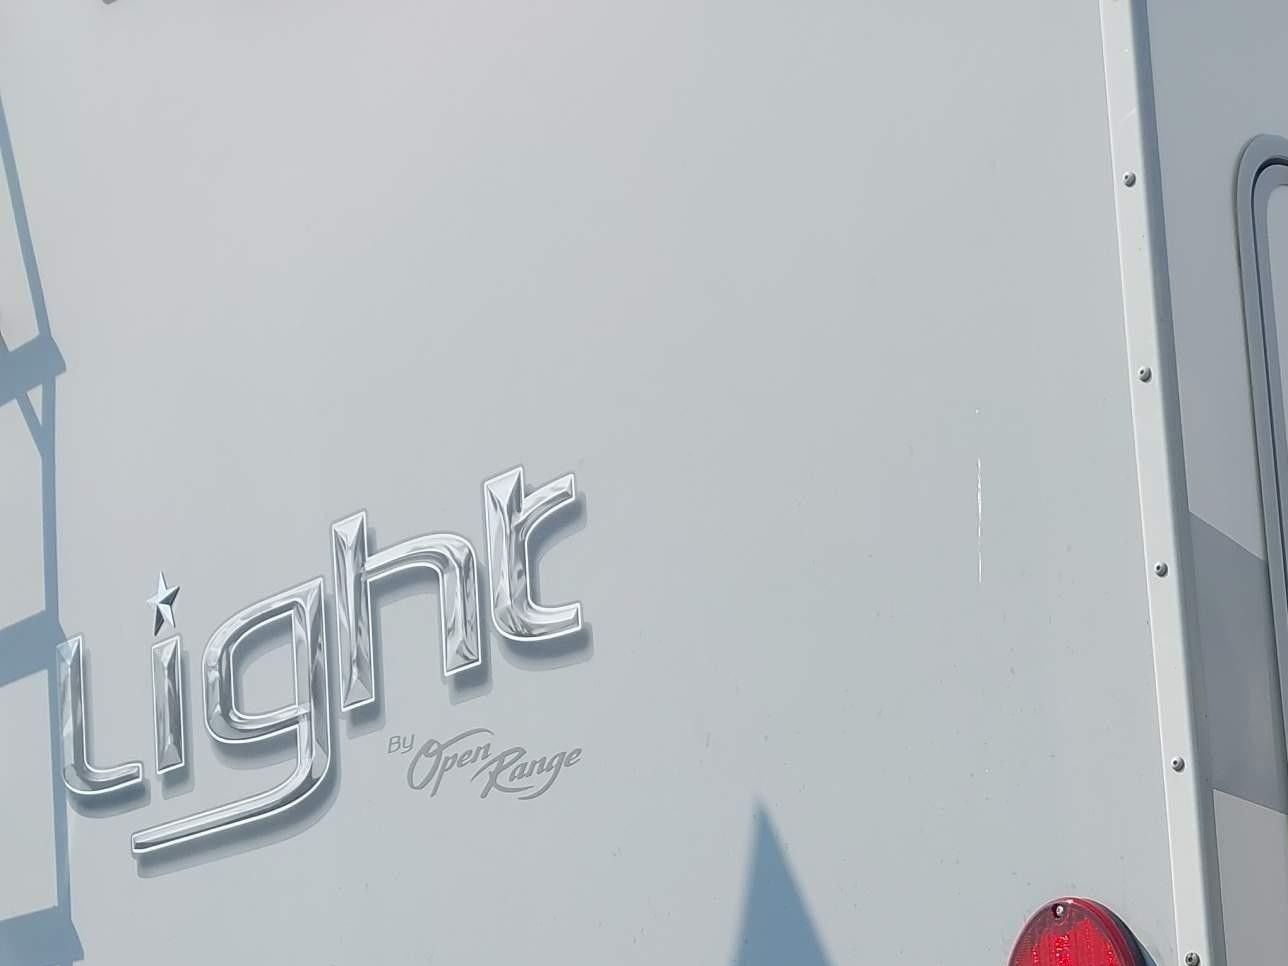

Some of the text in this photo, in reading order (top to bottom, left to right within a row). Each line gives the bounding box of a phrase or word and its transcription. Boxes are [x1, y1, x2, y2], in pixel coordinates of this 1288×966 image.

[56, 466, 582, 854] Light
[407, 728, 495, 798] Open
[470, 747, 583, 800] Range
